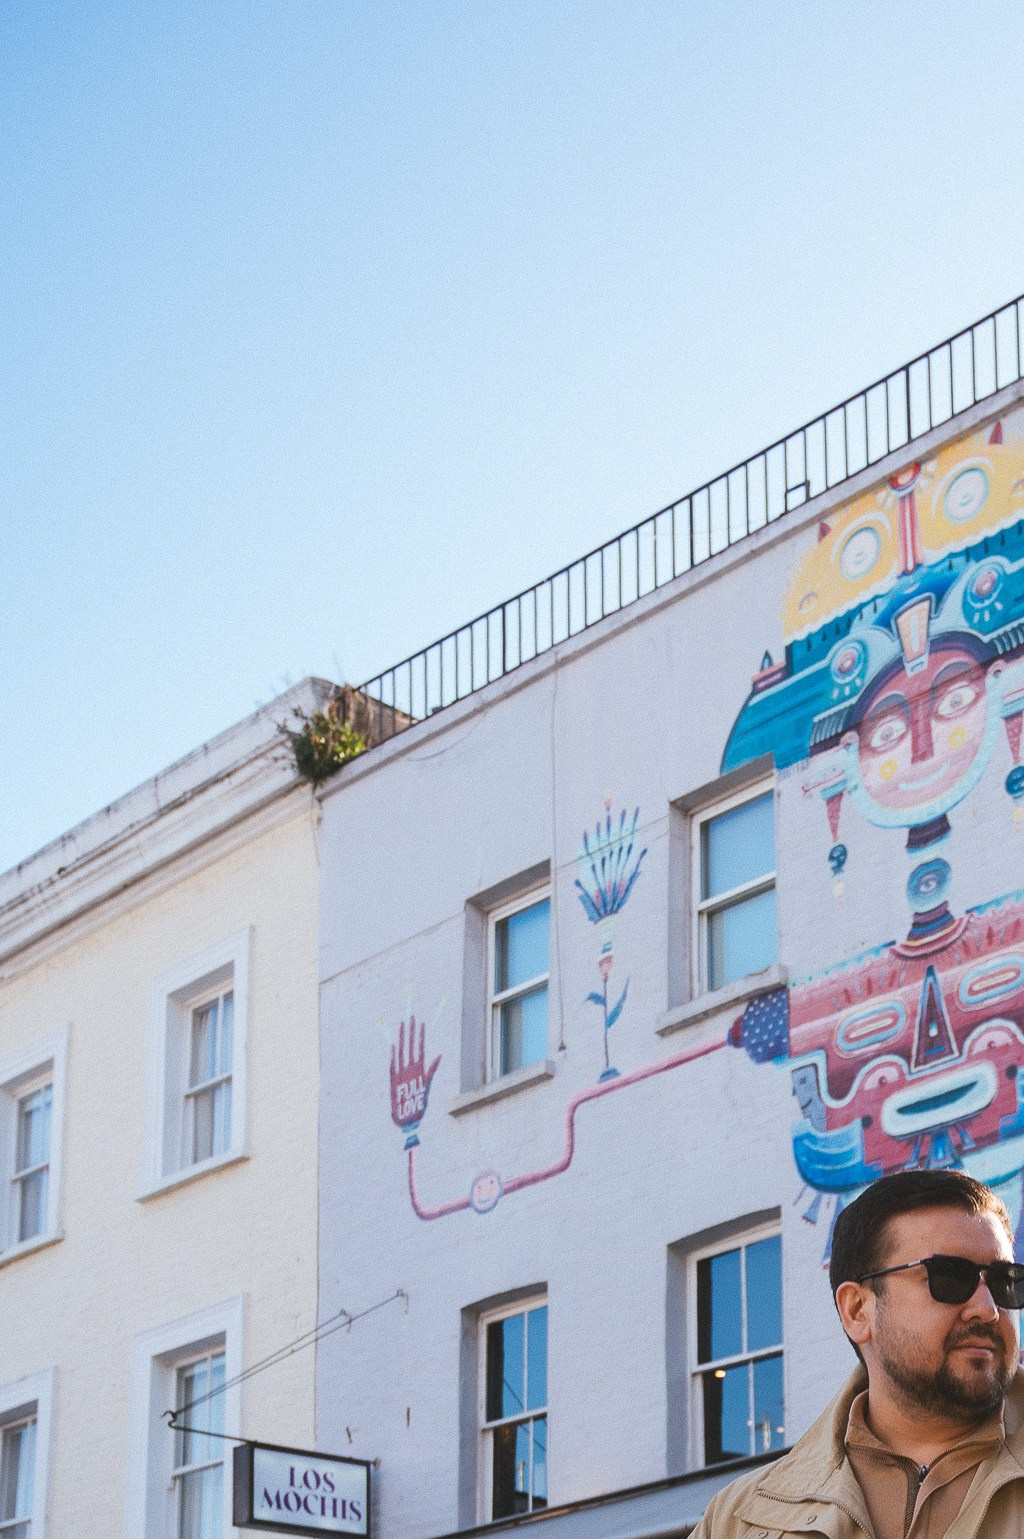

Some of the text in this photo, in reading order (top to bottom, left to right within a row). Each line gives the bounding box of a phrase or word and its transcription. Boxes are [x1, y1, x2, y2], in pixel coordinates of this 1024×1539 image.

[396, 1076, 426, 1102] FULL
[398, 1093, 425, 1120] LOVE
[290, 1466, 335, 1493] LOS
[262, 1487, 362, 1521] MOCHIS
